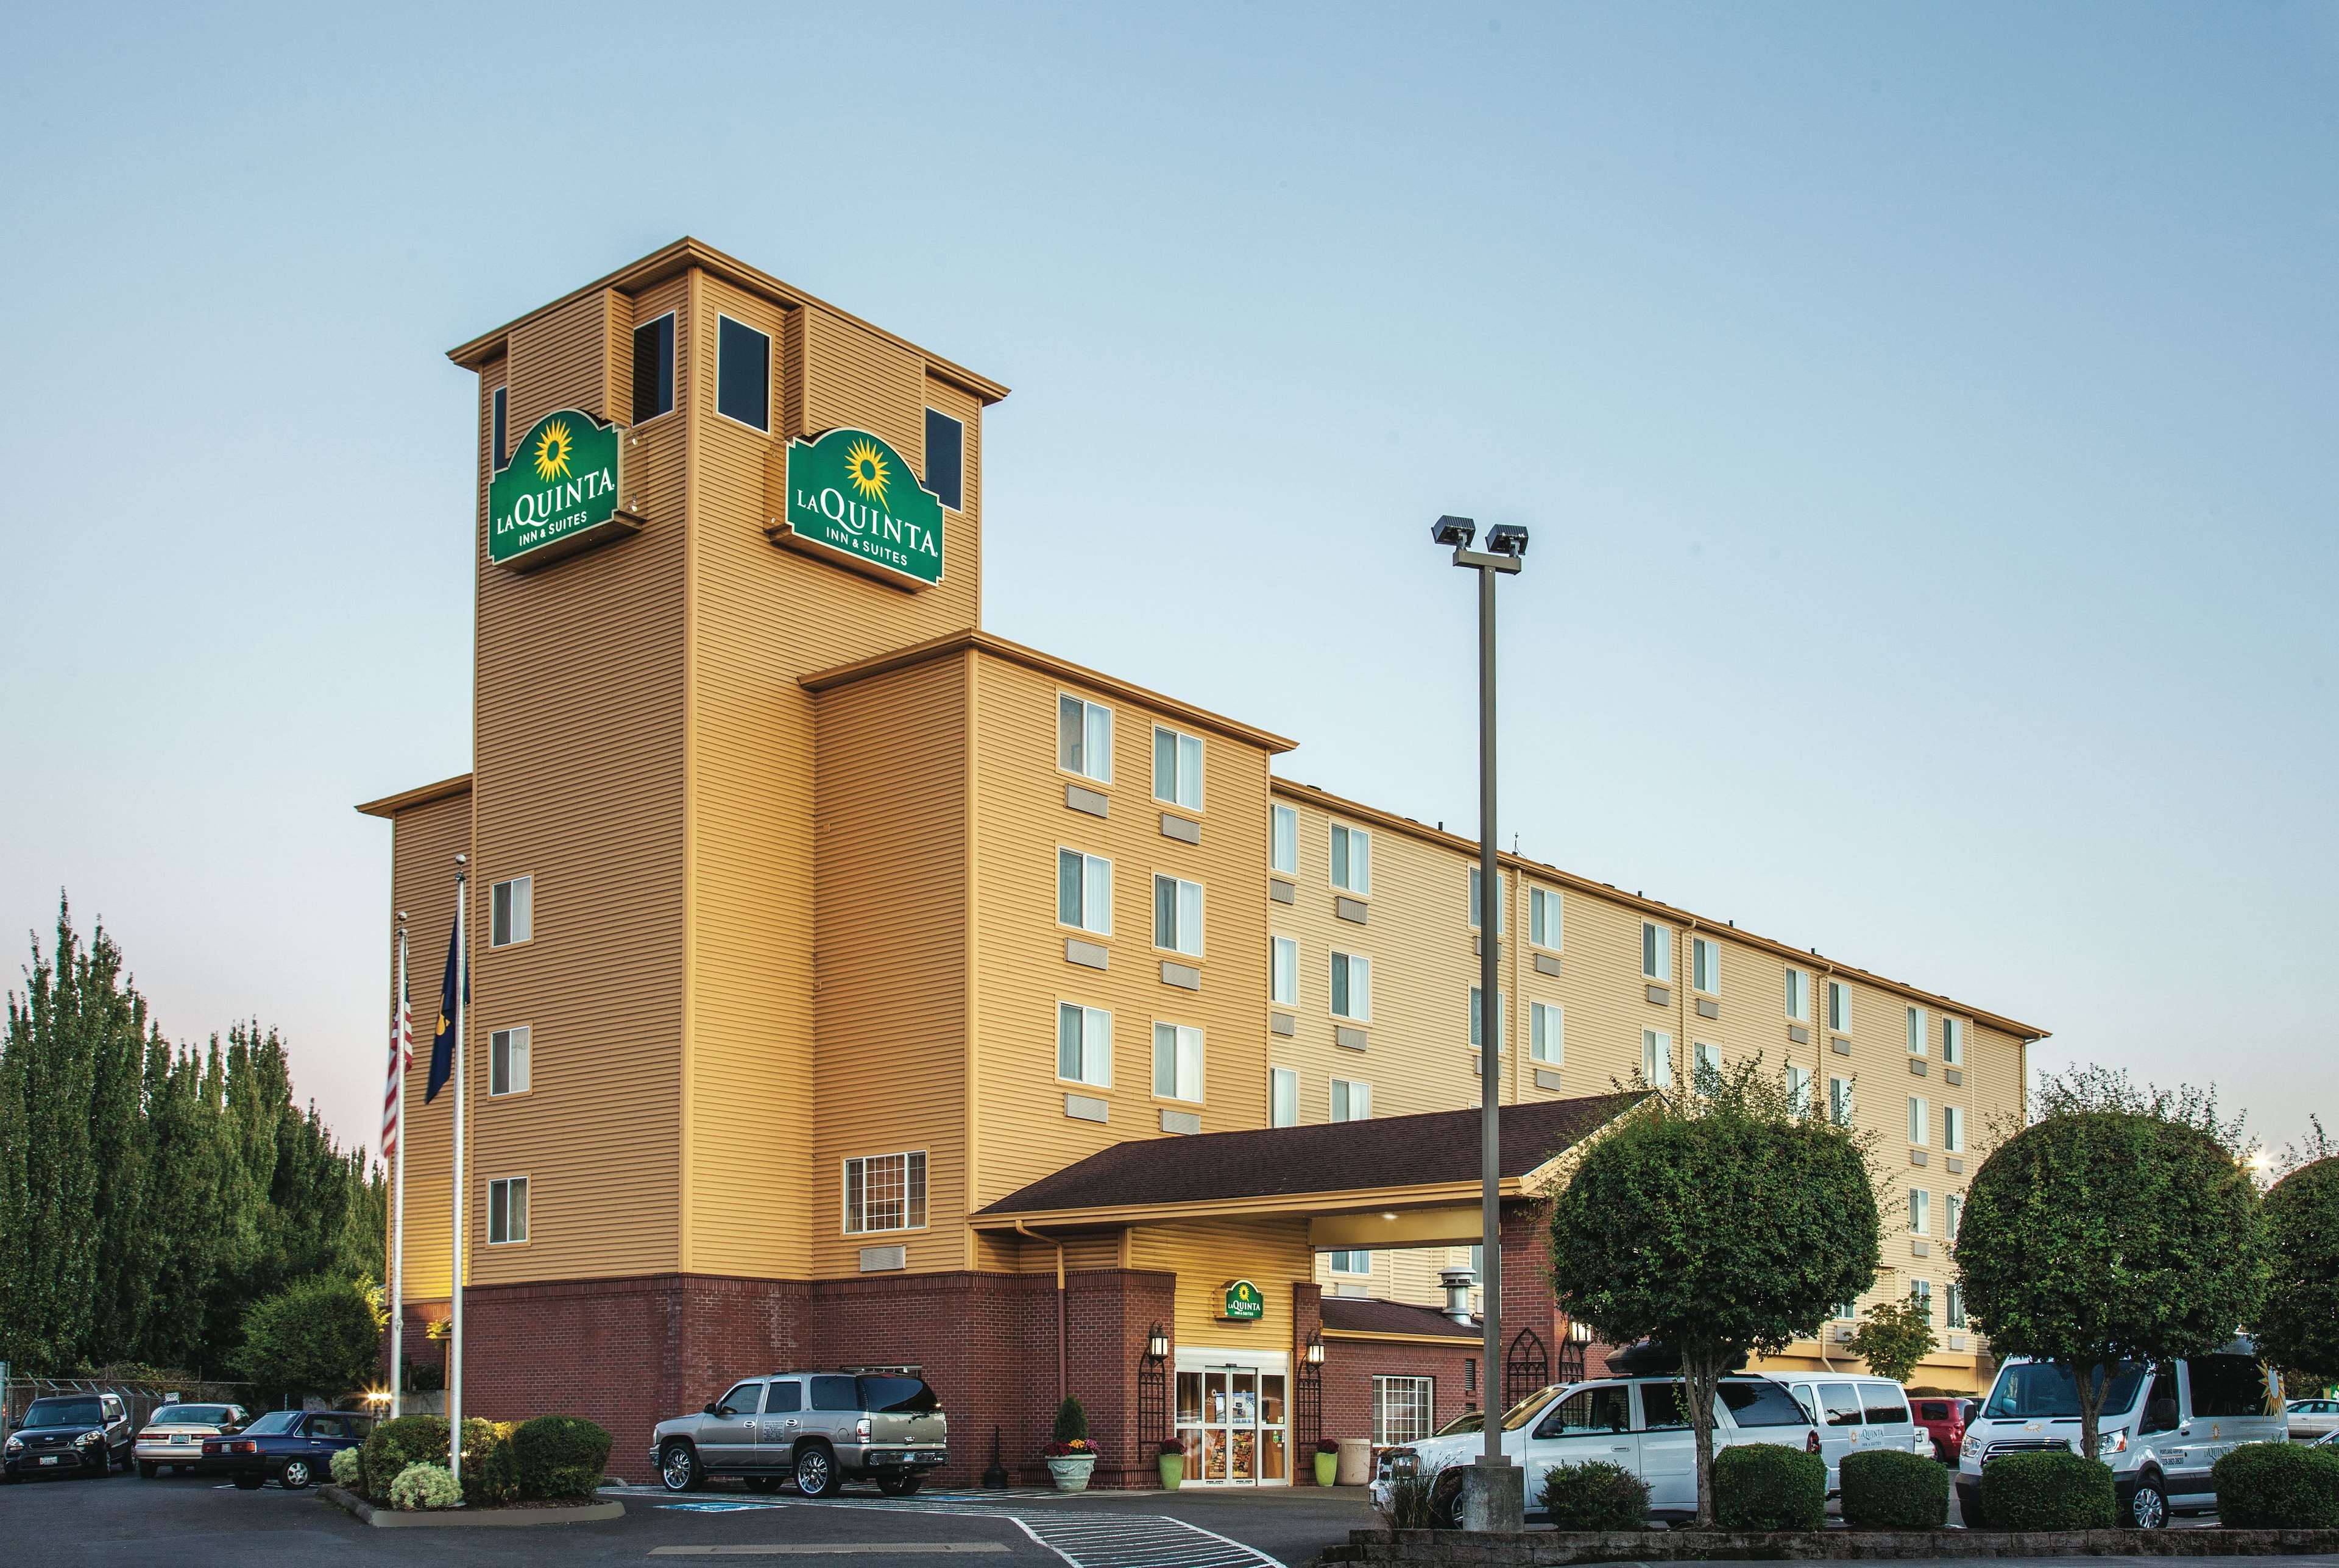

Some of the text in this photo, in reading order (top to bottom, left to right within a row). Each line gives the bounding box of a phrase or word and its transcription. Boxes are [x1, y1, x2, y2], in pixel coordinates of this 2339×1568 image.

[497, 467, 615, 534] LA QUINTA
[519, 511, 587, 546] INN & SUITES
[797, 488, 938, 557] LA QUINTA
[826, 527, 907, 566] INN & SUITES
[1233, 1300, 1261, 1312] QUINTA
[1863, 1429, 1884, 1441] QUINTA
